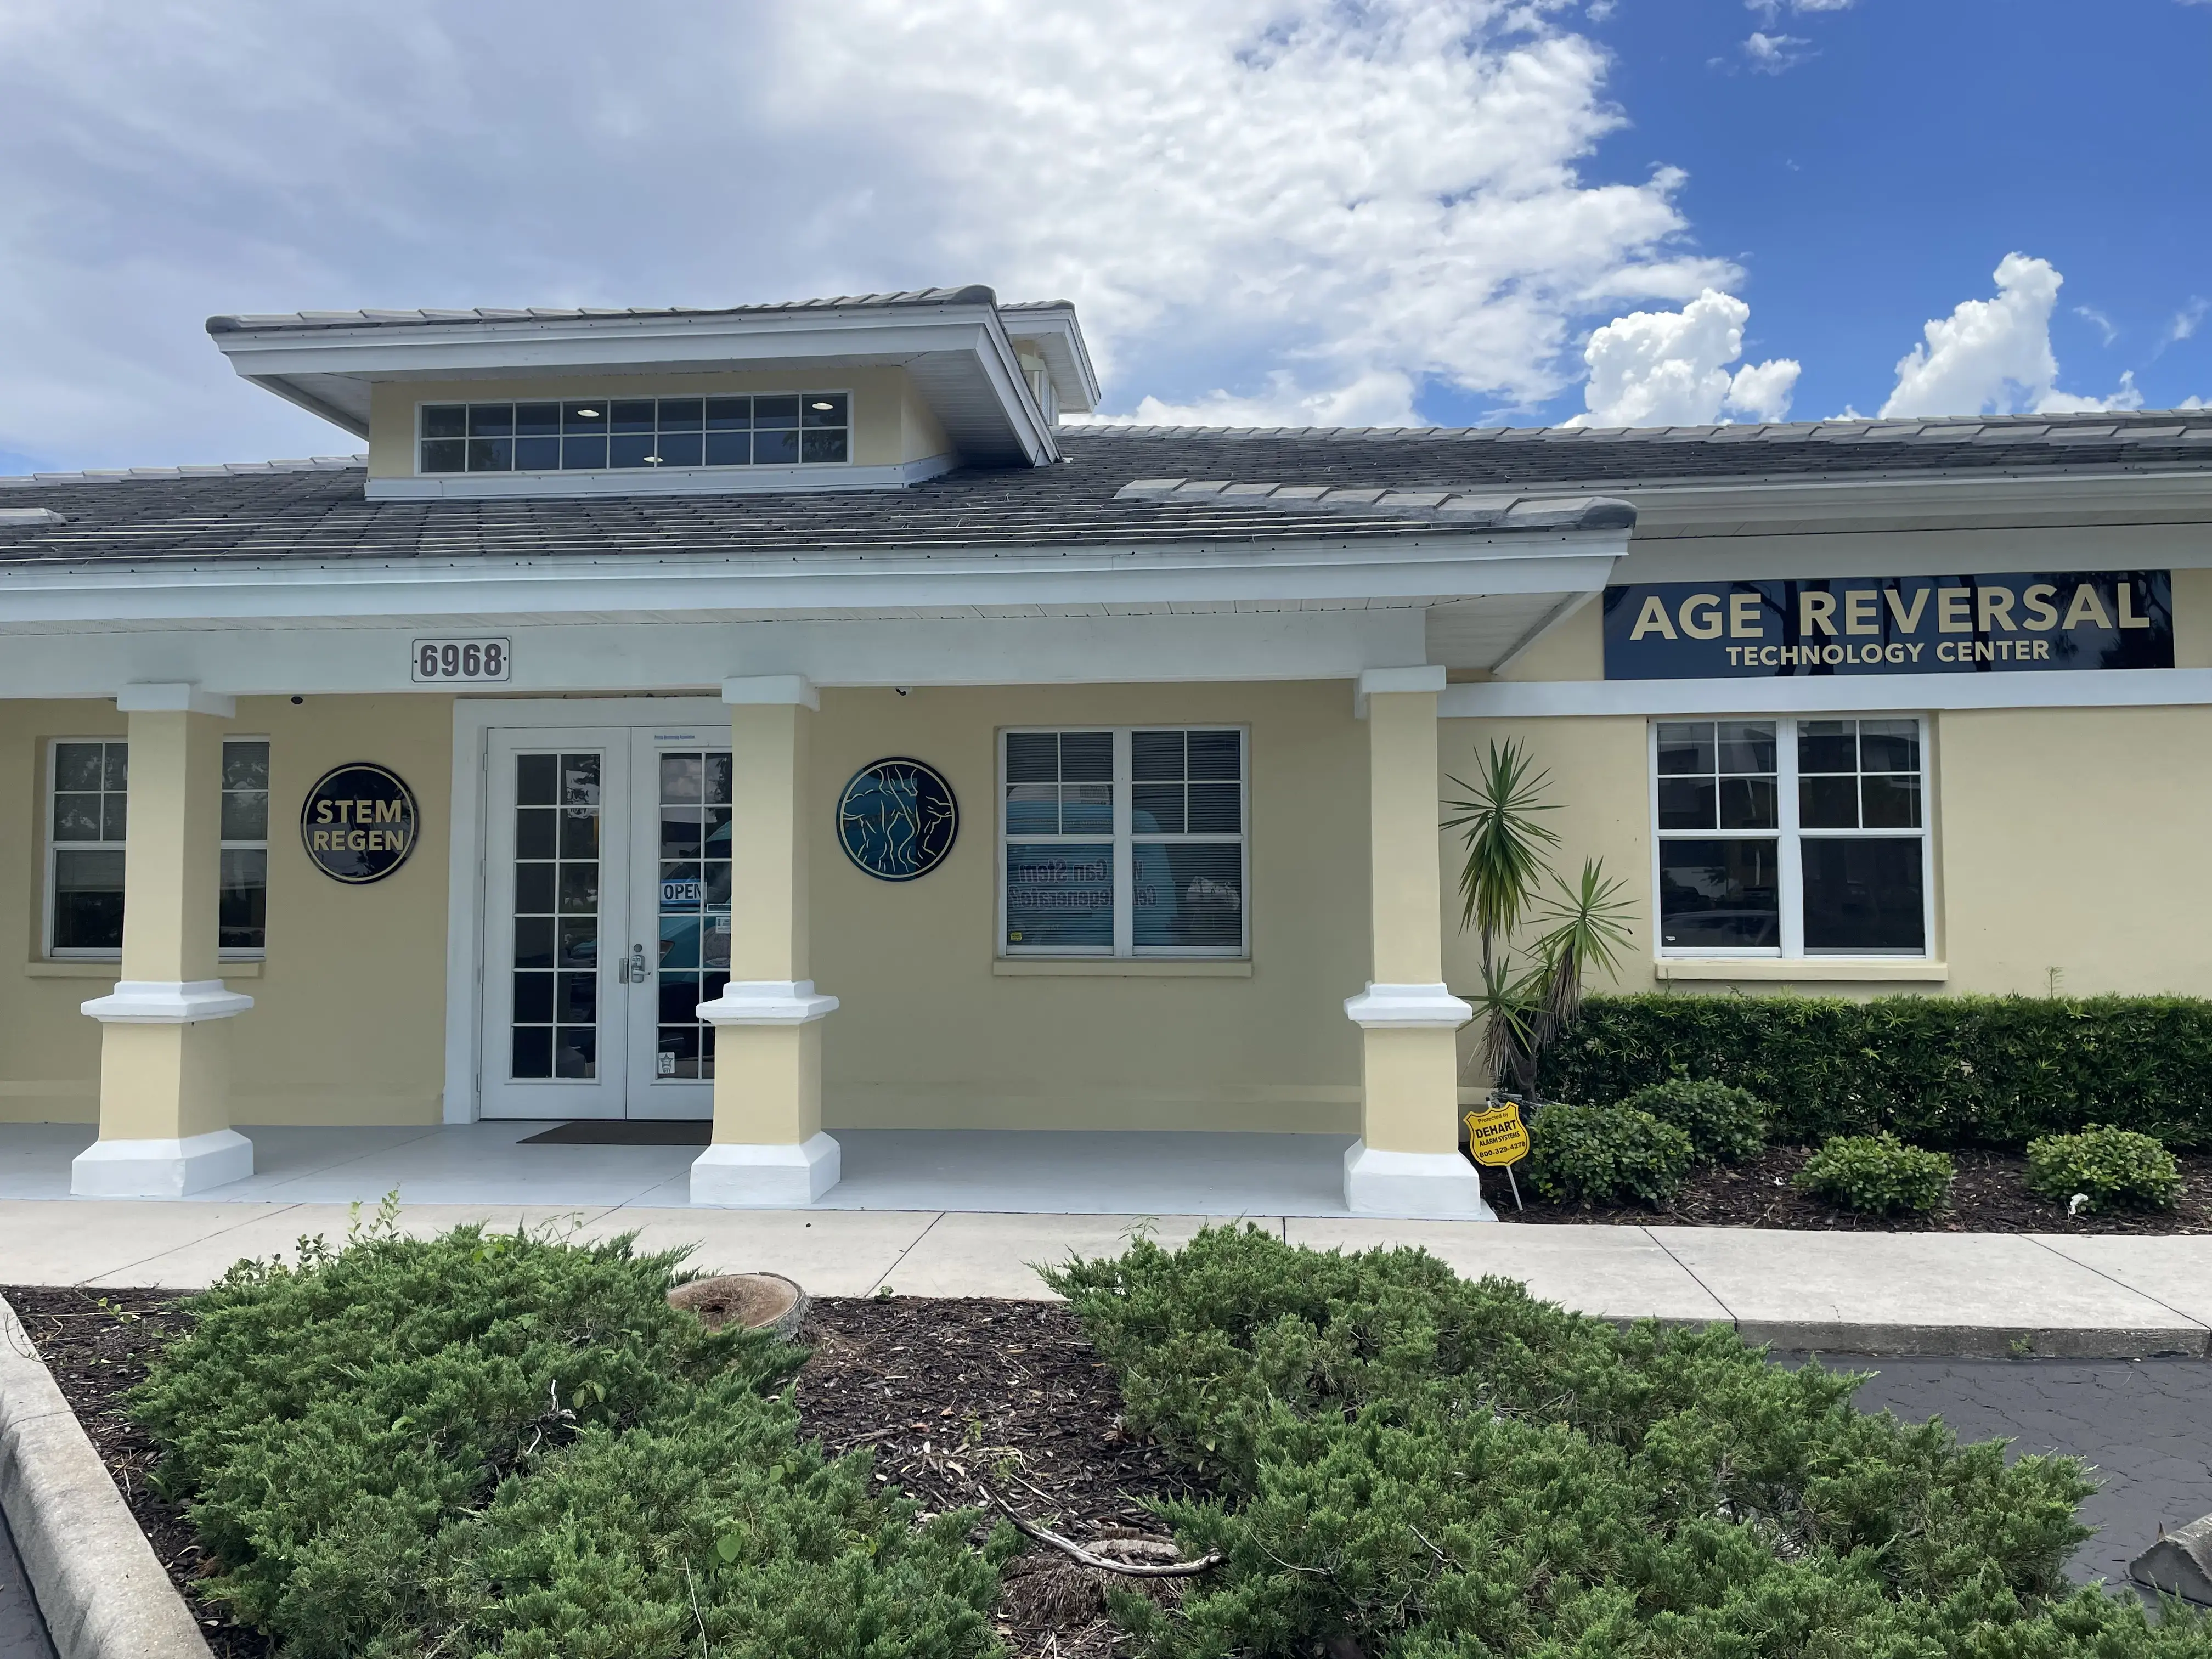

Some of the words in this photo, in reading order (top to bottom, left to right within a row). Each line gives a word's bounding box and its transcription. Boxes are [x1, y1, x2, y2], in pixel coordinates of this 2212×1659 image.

[1629, 593, 1764, 640] AGE
[1799, 582, 2151, 636] REVERSAL
[420, 644, 501, 677] 6968
[1726, 642, 1925, 667] TECHNOLOGY
[1936, 640, 2050, 663] CENTER
[317, 799, 402, 823] STEM
[314, 830, 404, 851] REGEN
[664, 884, 701, 900] OPEN
[1475, 1120, 1516, 1138] DEHART
[1477, 1114, 1502, 1124] Protected
[1479, 1137, 1498, 1147] ALARM
[1498, 1131, 1520, 1142] SYSTEMS
